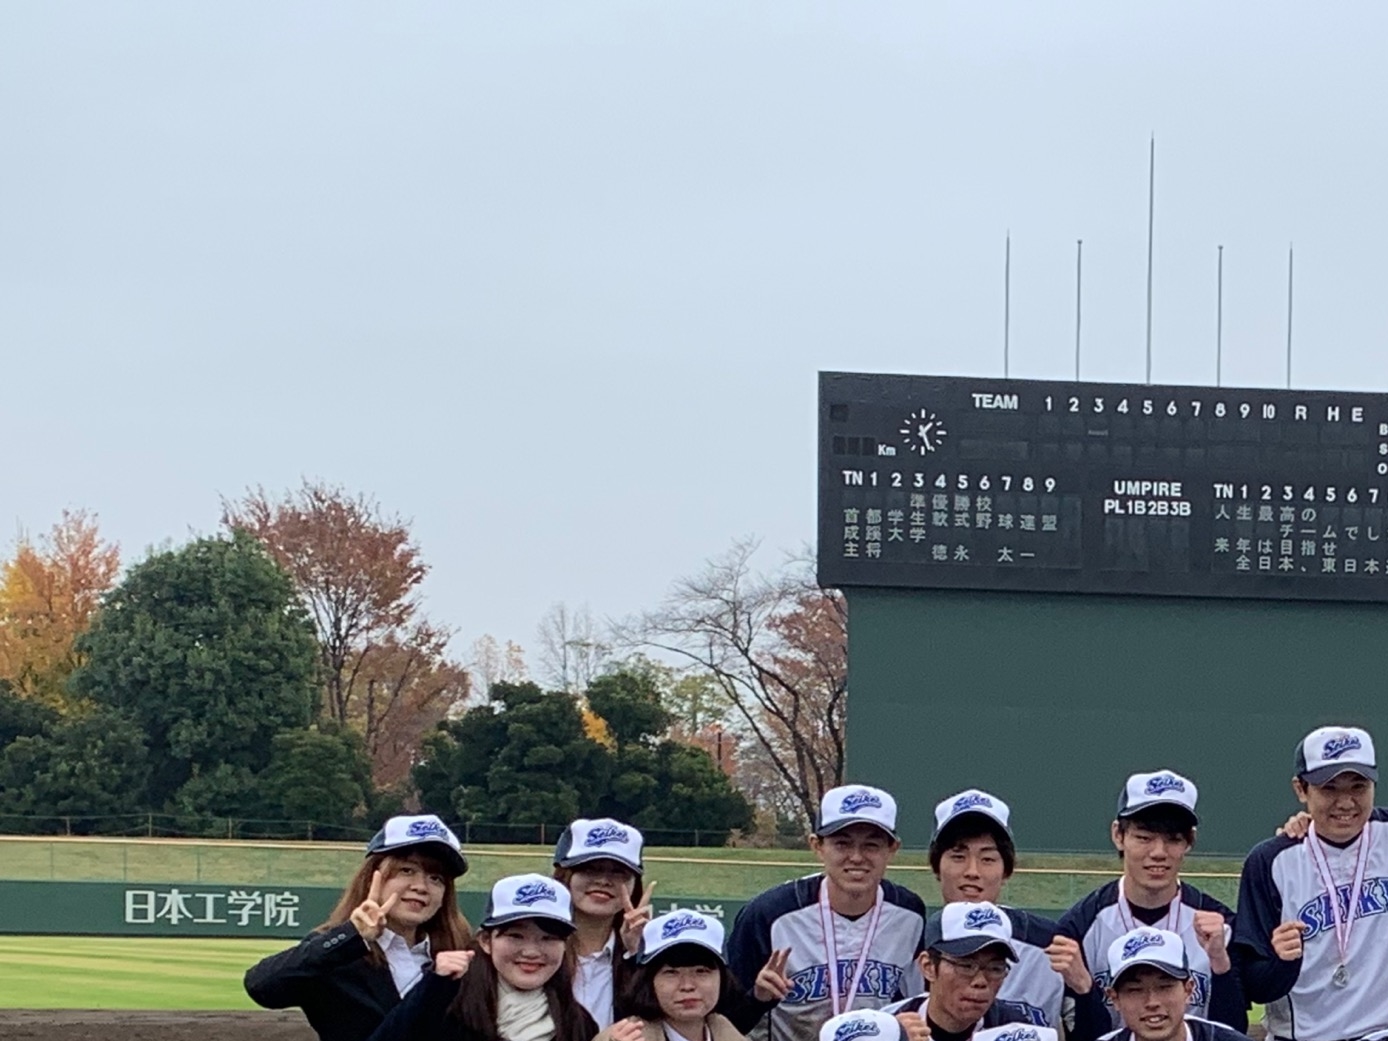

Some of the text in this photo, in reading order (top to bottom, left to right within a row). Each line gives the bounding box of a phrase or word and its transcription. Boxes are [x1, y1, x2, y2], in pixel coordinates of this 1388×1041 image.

[972, 393, 1364, 422] TEAM 1 2 3 4 5 6 7 8 9 10 R H E
[1379, 424, 1388, 436] B
[878, 444, 896, 457] Km
[1379, 443, 1388, 455] S
[842, 470, 1056, 492] TN 1 2 3 4 5 6 7 8 9
[1114, 481, 1182, 497] UMPIRE
[1213, 484, 1234, 499] TN
[1240, 484, 1248, 498] 1
[1261, 485, 1271, 499] 2
[1282, 486, 1293, 500] 3
[1303, 486, 1315, 501] 4
[1325, 487, 1336, 501] 5
[1347, 488, 1358, 502] 6
[1368, 489, 1379, 503] 7
[844, 508, 1058, 531] 首都学生軟式野球連盟
[1215, 504, 1317, 522] 人生最高の
[844, 525, 926, 543] 成蹊大学
[844, 542, 882, 559] 主将
[1215, 538, 1337, 556] 来年は目指せ
[125, 888, 300, 927] 日本工学院
